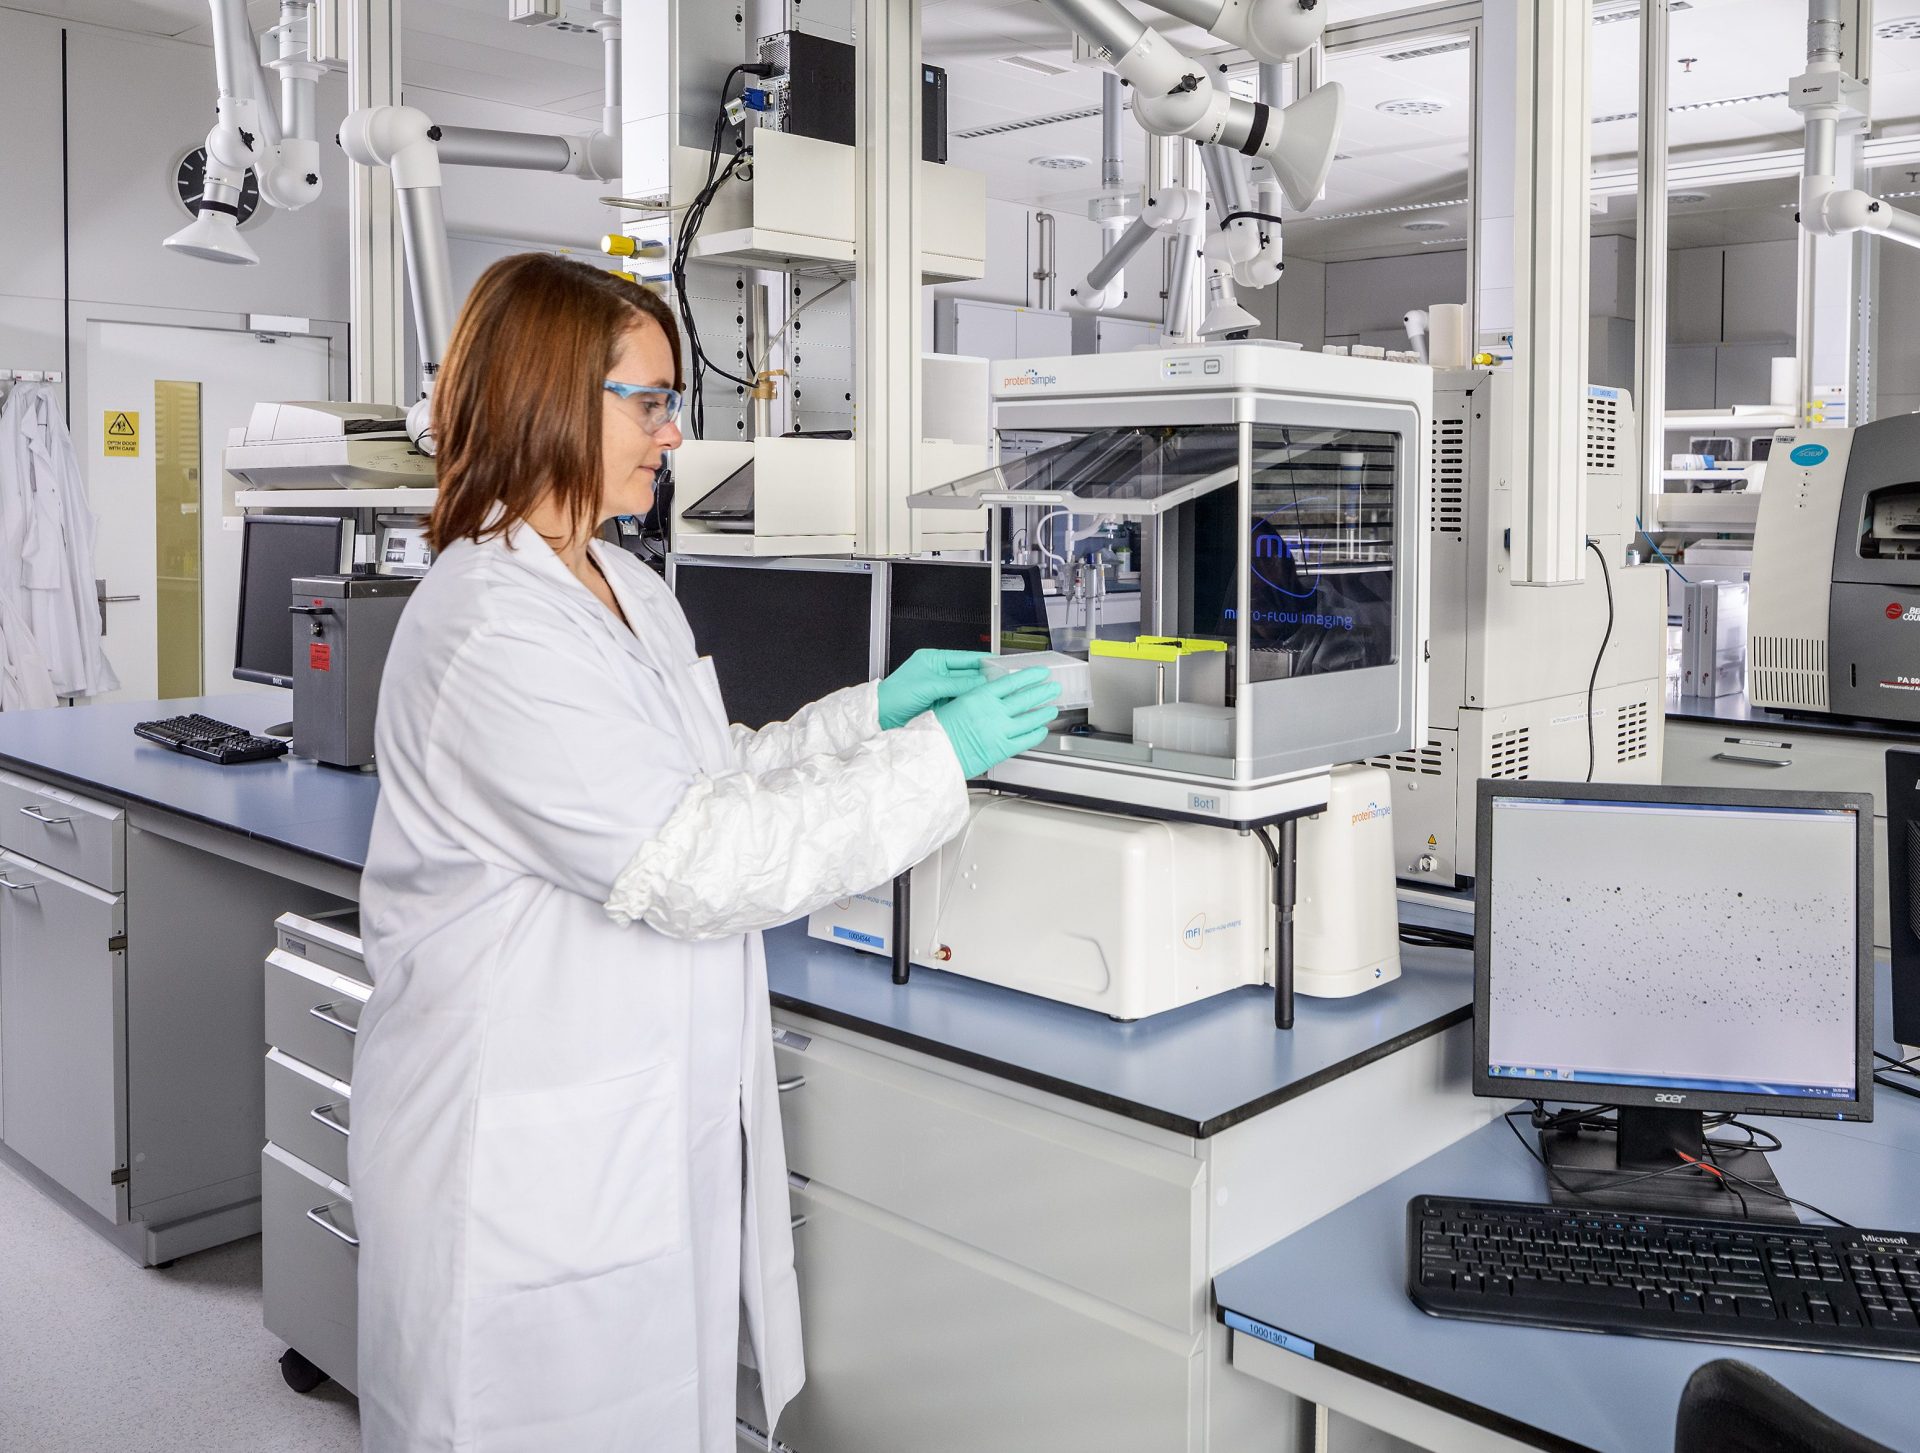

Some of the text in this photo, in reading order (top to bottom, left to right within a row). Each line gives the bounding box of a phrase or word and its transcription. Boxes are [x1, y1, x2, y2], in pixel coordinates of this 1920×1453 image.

[1004, 375, 1056, 388] proteinsimple
[1194, 796, 1214, 809] Bot1
[1654, 1093, 1687, 1104] acer
[1861, 1234, 1909, 1245] Microsoft
